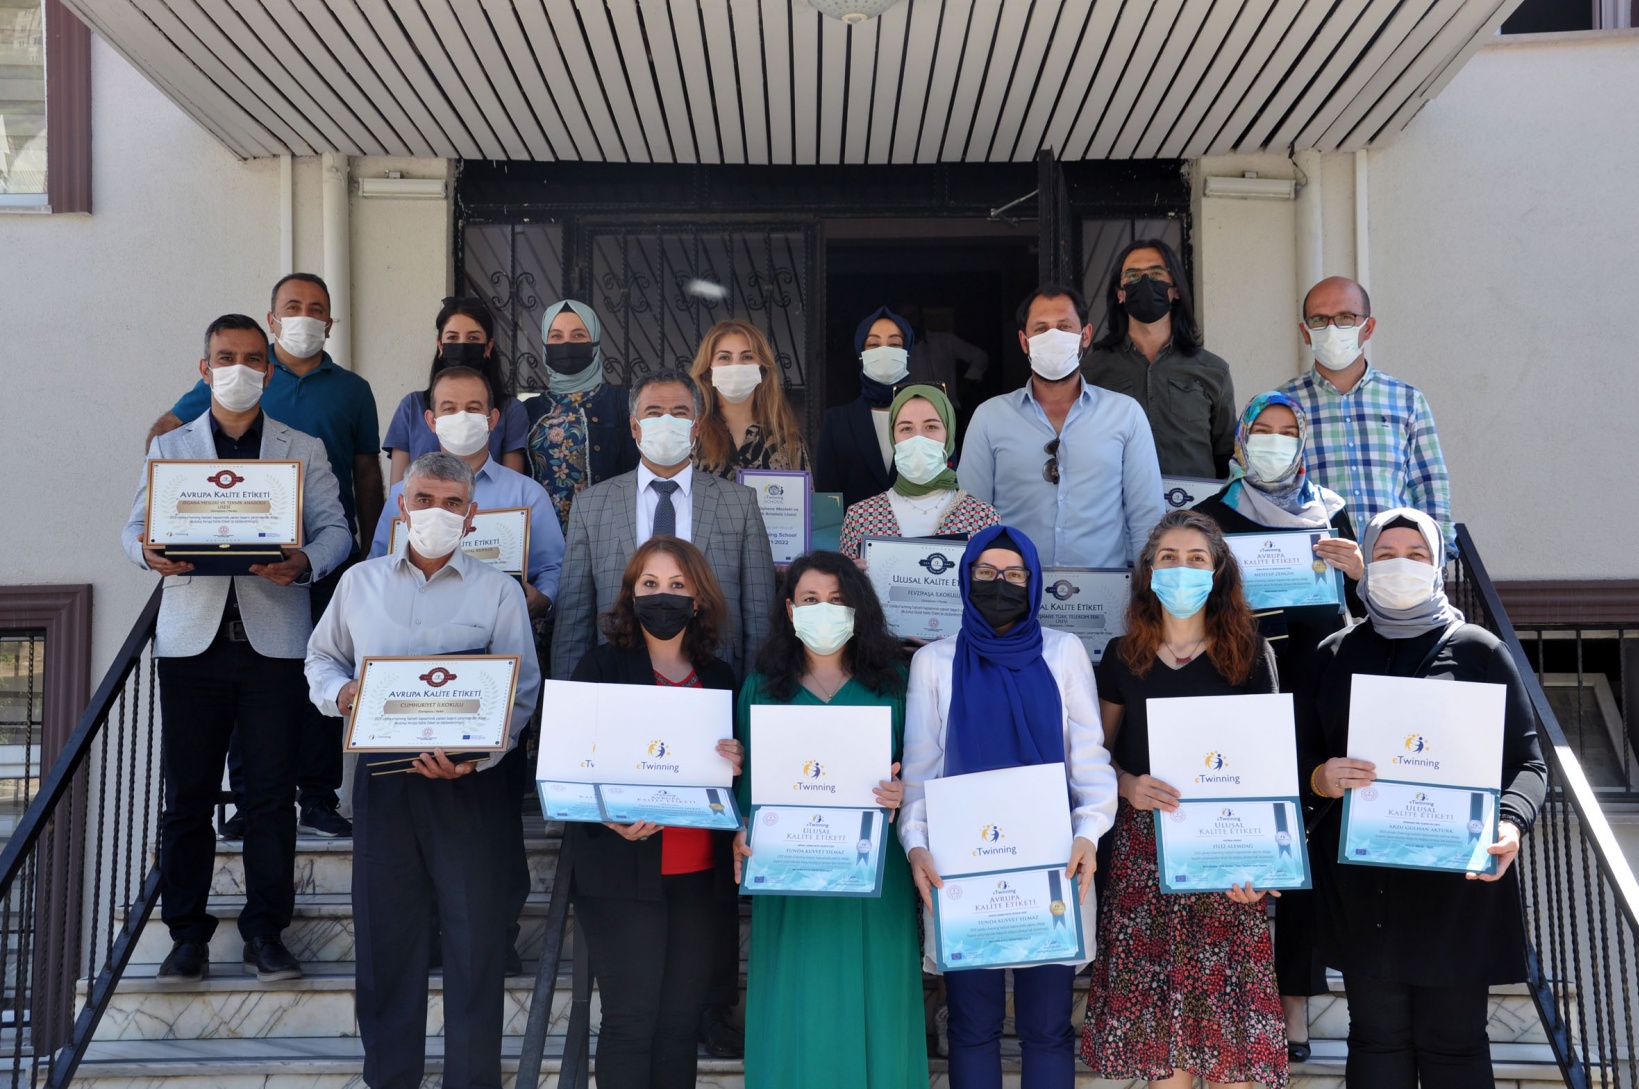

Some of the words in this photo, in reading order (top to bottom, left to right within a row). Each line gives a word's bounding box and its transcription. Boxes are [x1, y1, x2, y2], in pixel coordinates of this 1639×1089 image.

[474, 538, 500, 546] ETİKETİ
[892, 575, 922, 584] ULUSAL
[924, 577, 950, 586] KALİTE
[636, 762, 680, 774] eTwinning
[1392, 756, 1440, 770] eTwinning
[1194, 774, 1240, 784] eTwinning
[793, 782, 836, 793] eTwinning
[1406, 805, 1436, 813] ULUSAL
[972, 846, 1017, 857] eTwinning
[990, 895, 1020, 904] AVRUPA
